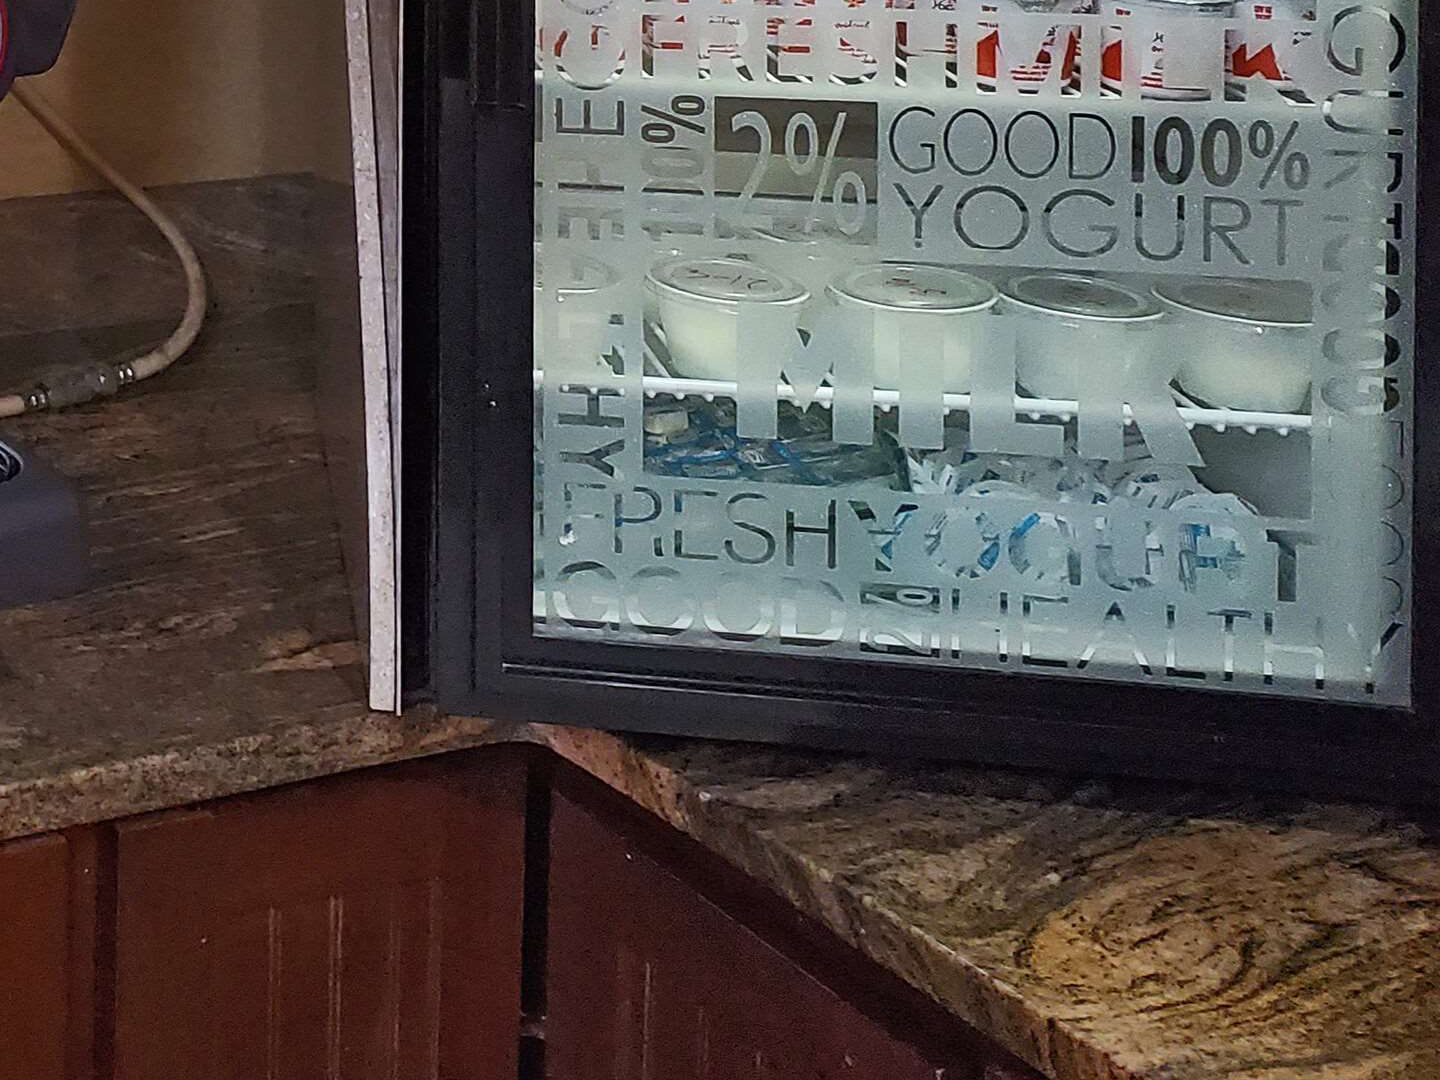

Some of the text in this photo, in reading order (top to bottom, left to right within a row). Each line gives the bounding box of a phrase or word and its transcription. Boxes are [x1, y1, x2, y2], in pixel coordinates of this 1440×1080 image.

[640, 13, 1317, 108] FRESH MILK
[731, 110, 867, 237] 2%
[888, 105, 1312, 192] GOOD 100%
[893, 183, 1304, 267] YOGURT
[736, 300, 1203, 468] MILK
[563, 481, 838, 570] FRESH
[848, 498, 1317, 603] YOGURT
[552, 560, 846, 648] GOOD
